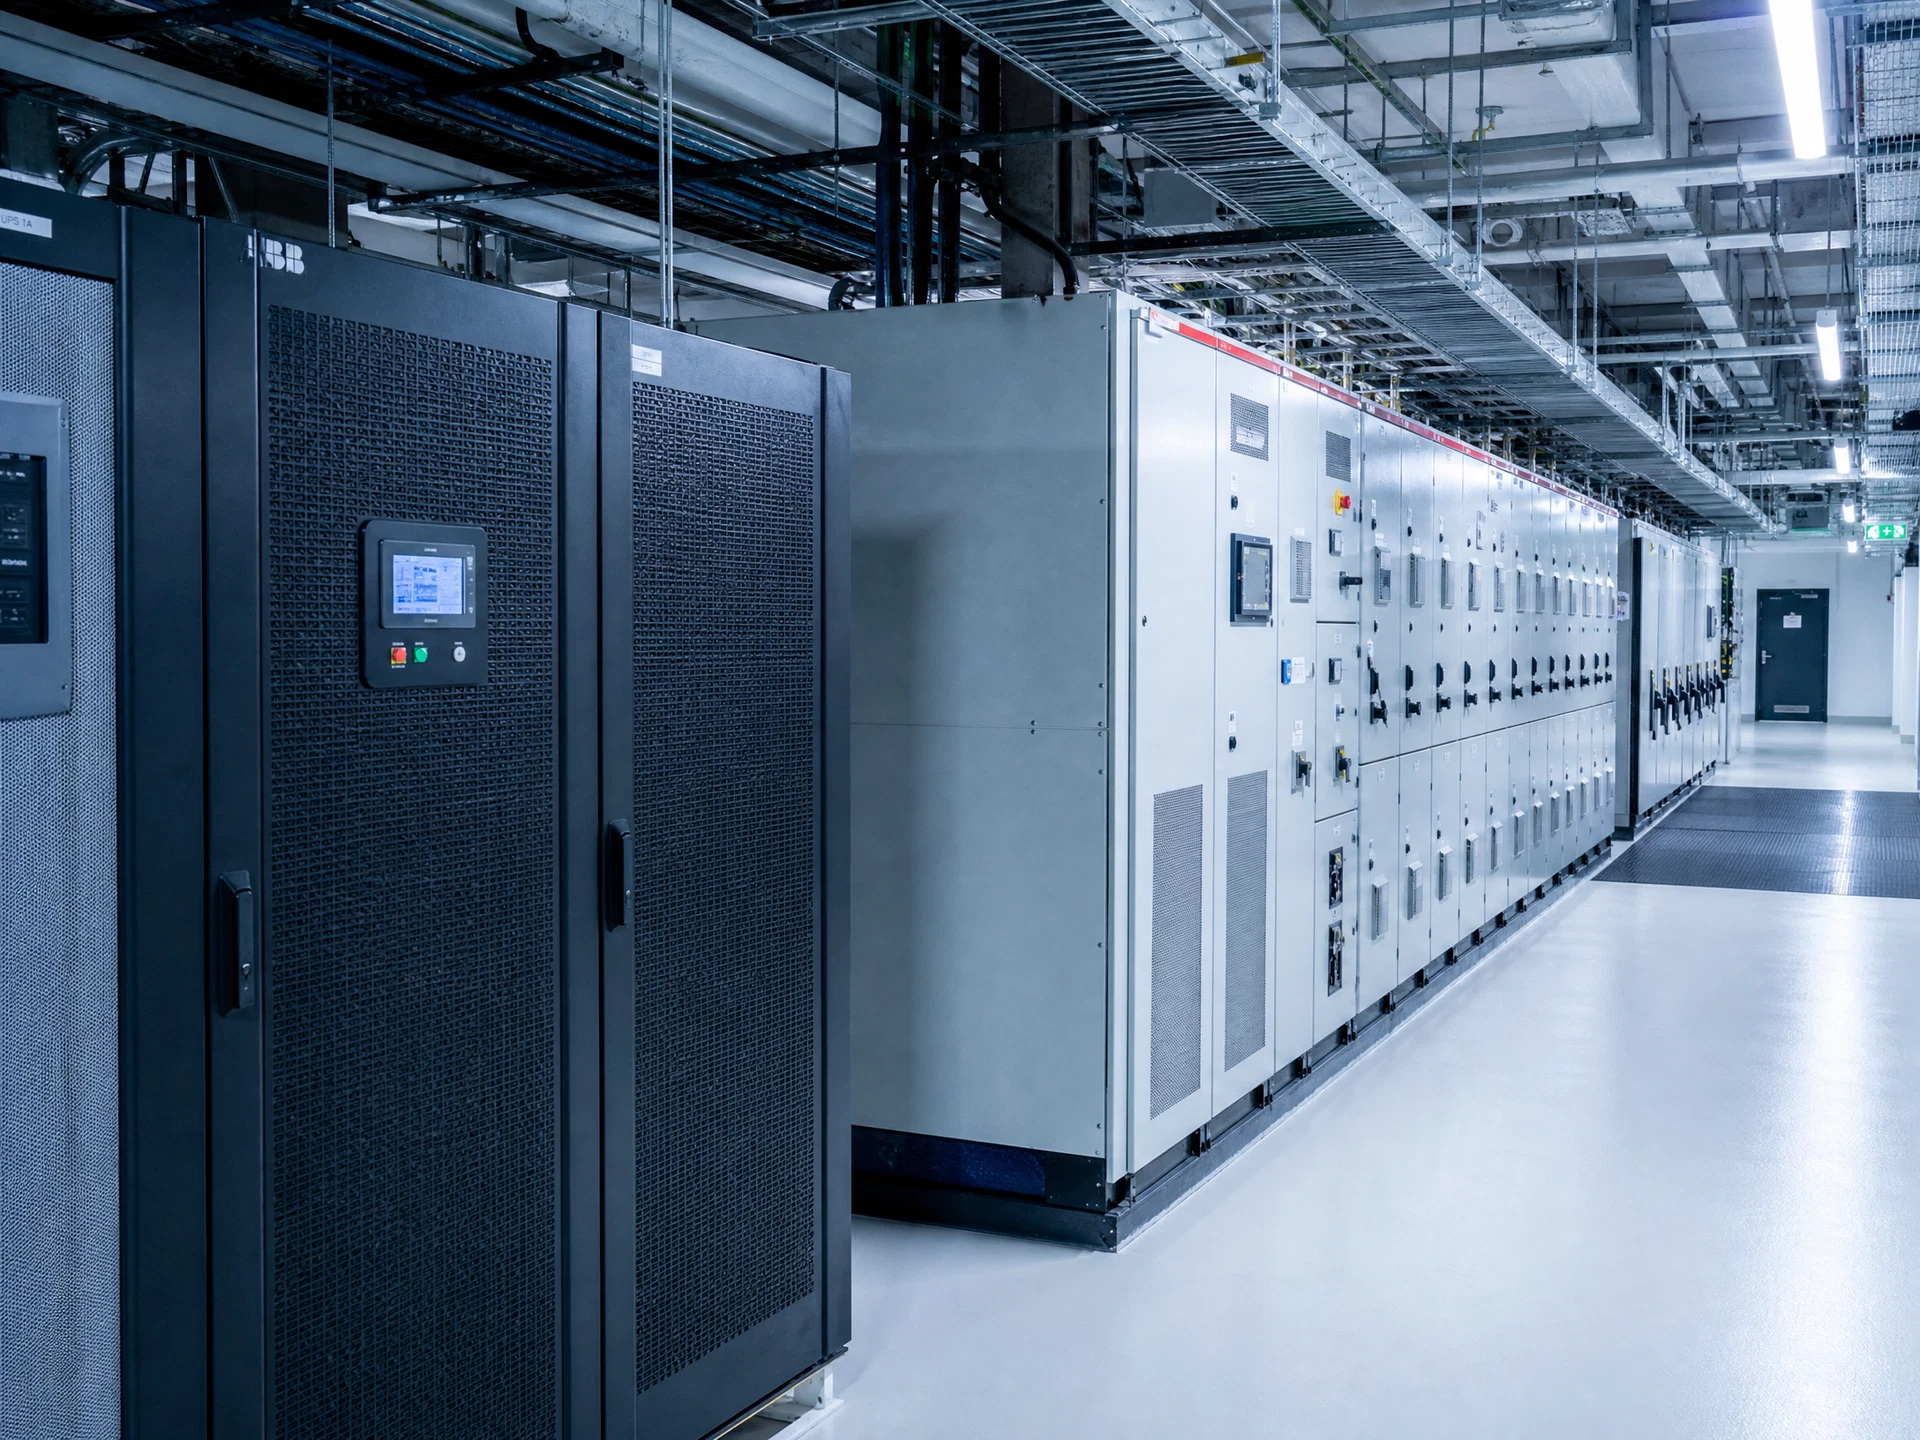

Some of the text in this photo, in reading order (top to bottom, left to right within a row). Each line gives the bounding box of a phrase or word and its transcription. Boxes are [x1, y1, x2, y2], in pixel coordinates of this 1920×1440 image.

[1, 214, 33, 228] UPS 1A
[241, 234, 305, 275] ABB
